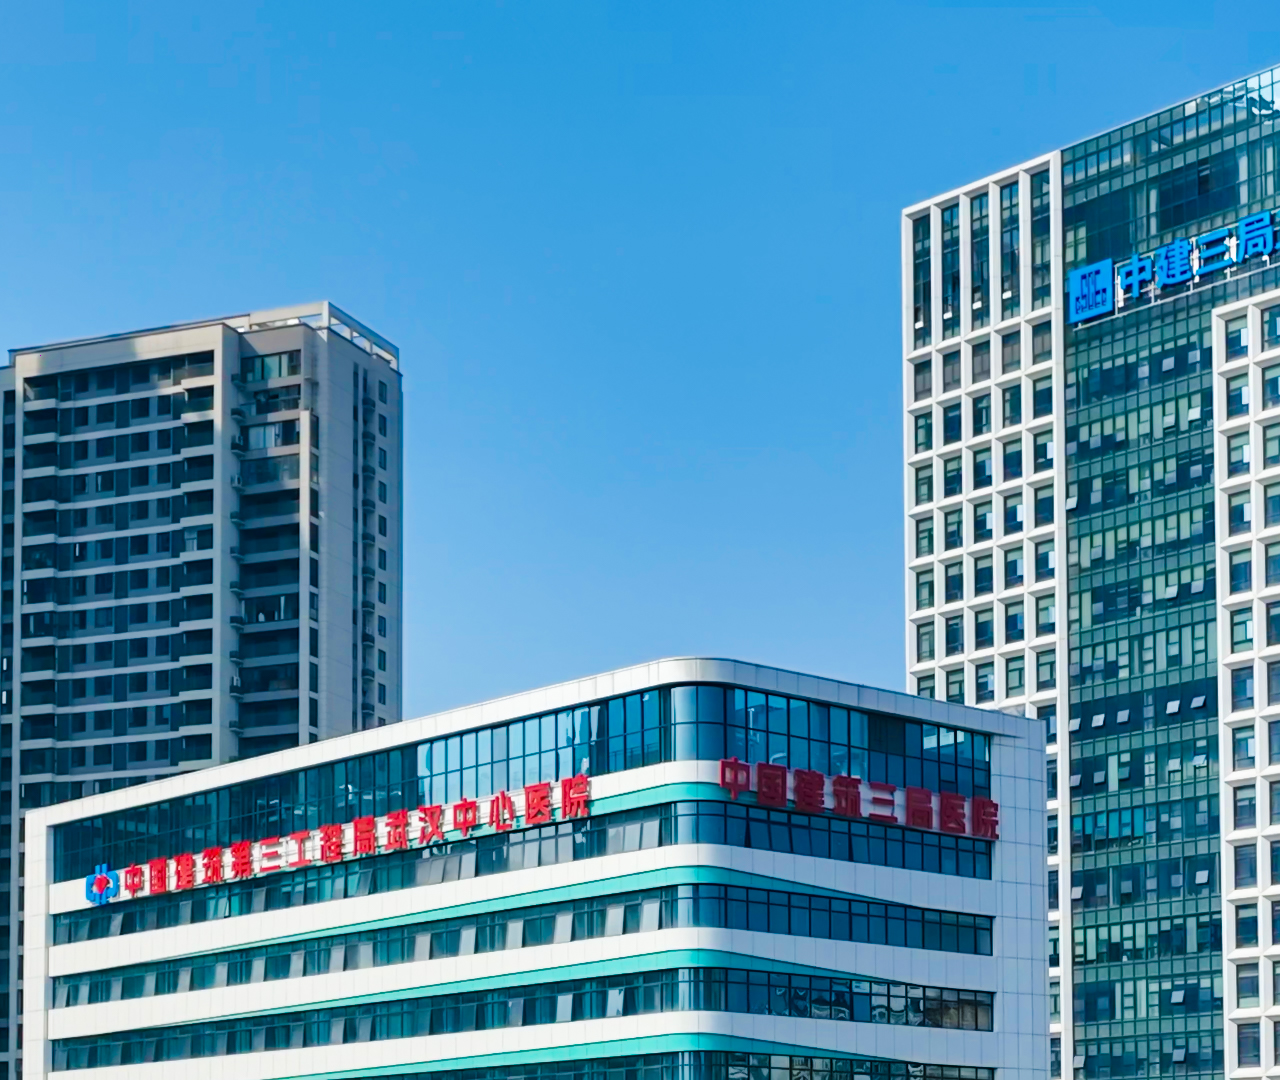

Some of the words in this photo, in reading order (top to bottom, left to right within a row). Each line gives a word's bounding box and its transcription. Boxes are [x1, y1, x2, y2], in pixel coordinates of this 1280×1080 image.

[124, 773, 589, 897] 中国建筑第三工程局武汉中心医院
[718, 756, 1000, 840] 中国建筑三局医院
